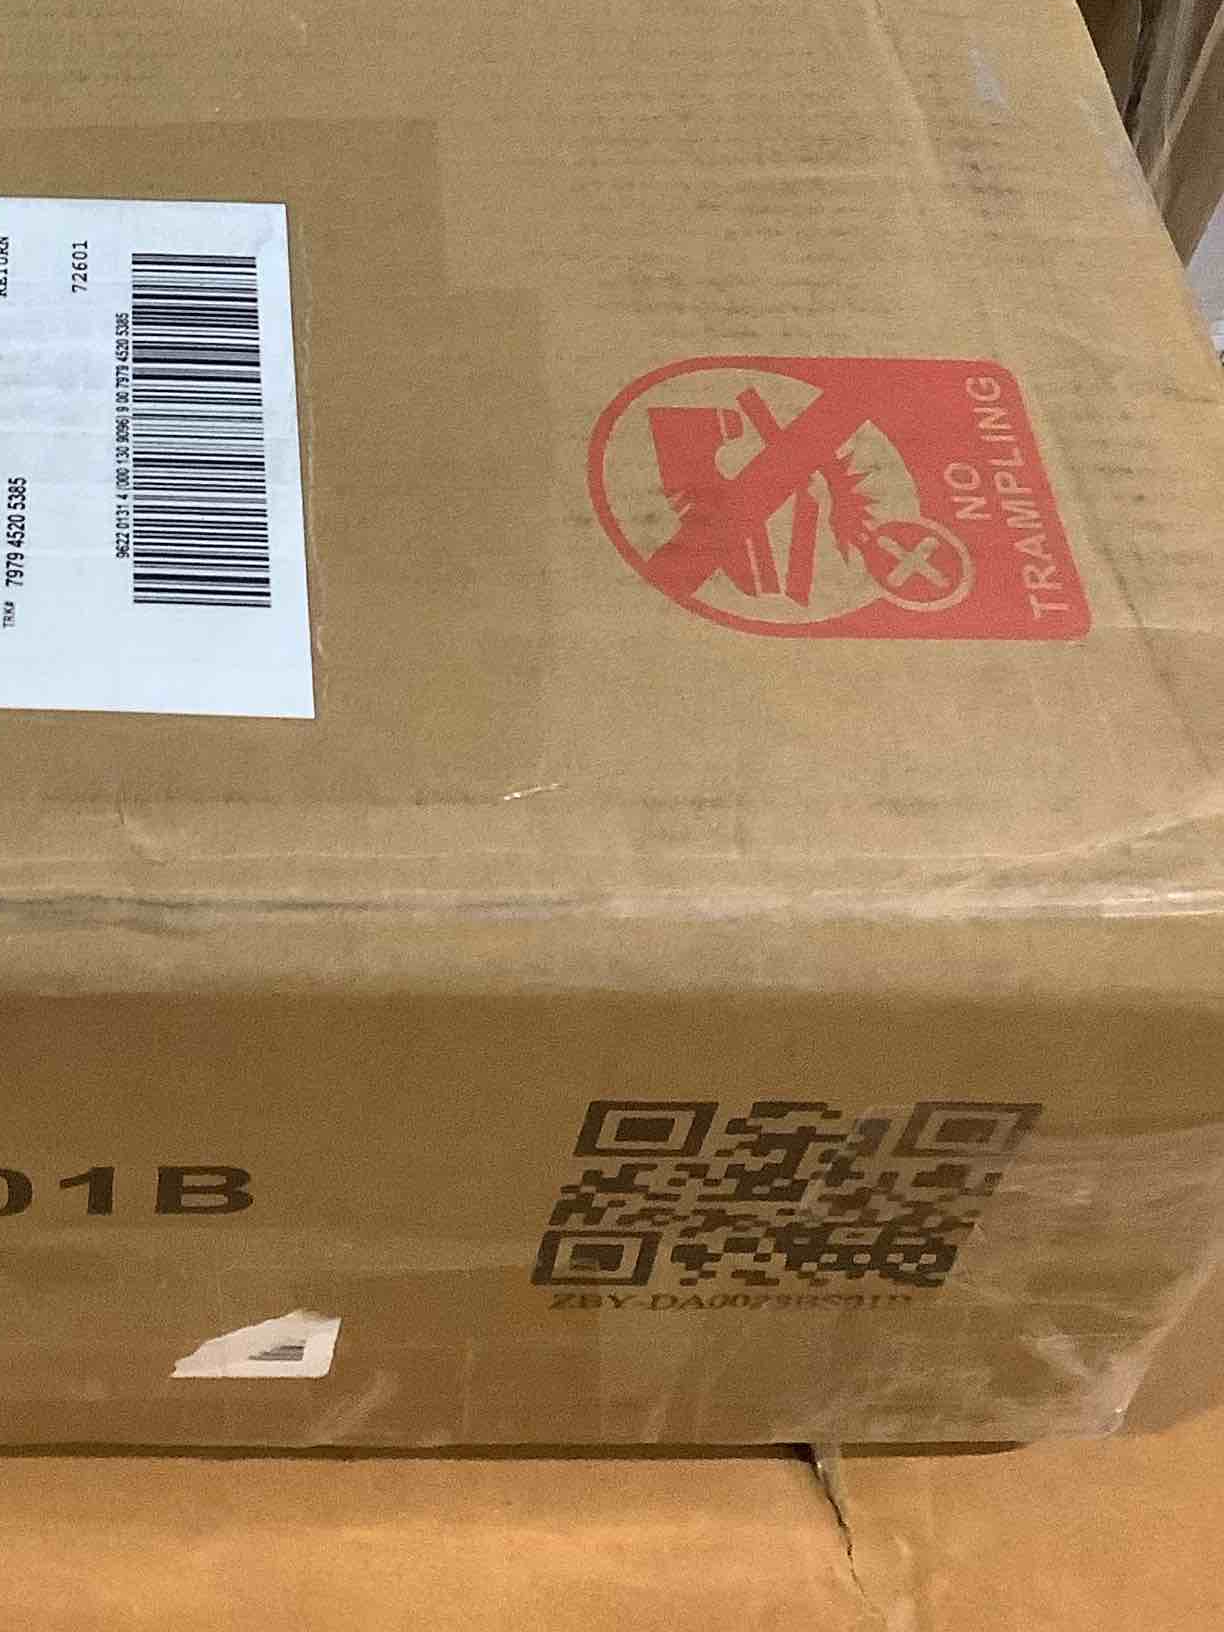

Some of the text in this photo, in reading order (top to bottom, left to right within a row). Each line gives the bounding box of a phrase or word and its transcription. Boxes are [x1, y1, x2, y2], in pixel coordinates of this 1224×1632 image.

[72, 240, 89, 294] 72601
[116, 312, 130, 337] 5385
[116, 338, 130, 363] 4520
[116, 365, 130, 389] 7979
[944, 462, 993, 521] NO
[966, 375, 1073, 619] TRAMPLING
[116, 504, 130, 529] 0131
[2, 477, 27, 628] TRK# 7979 4520 5385
[116, 533, 130, 559] 9622
